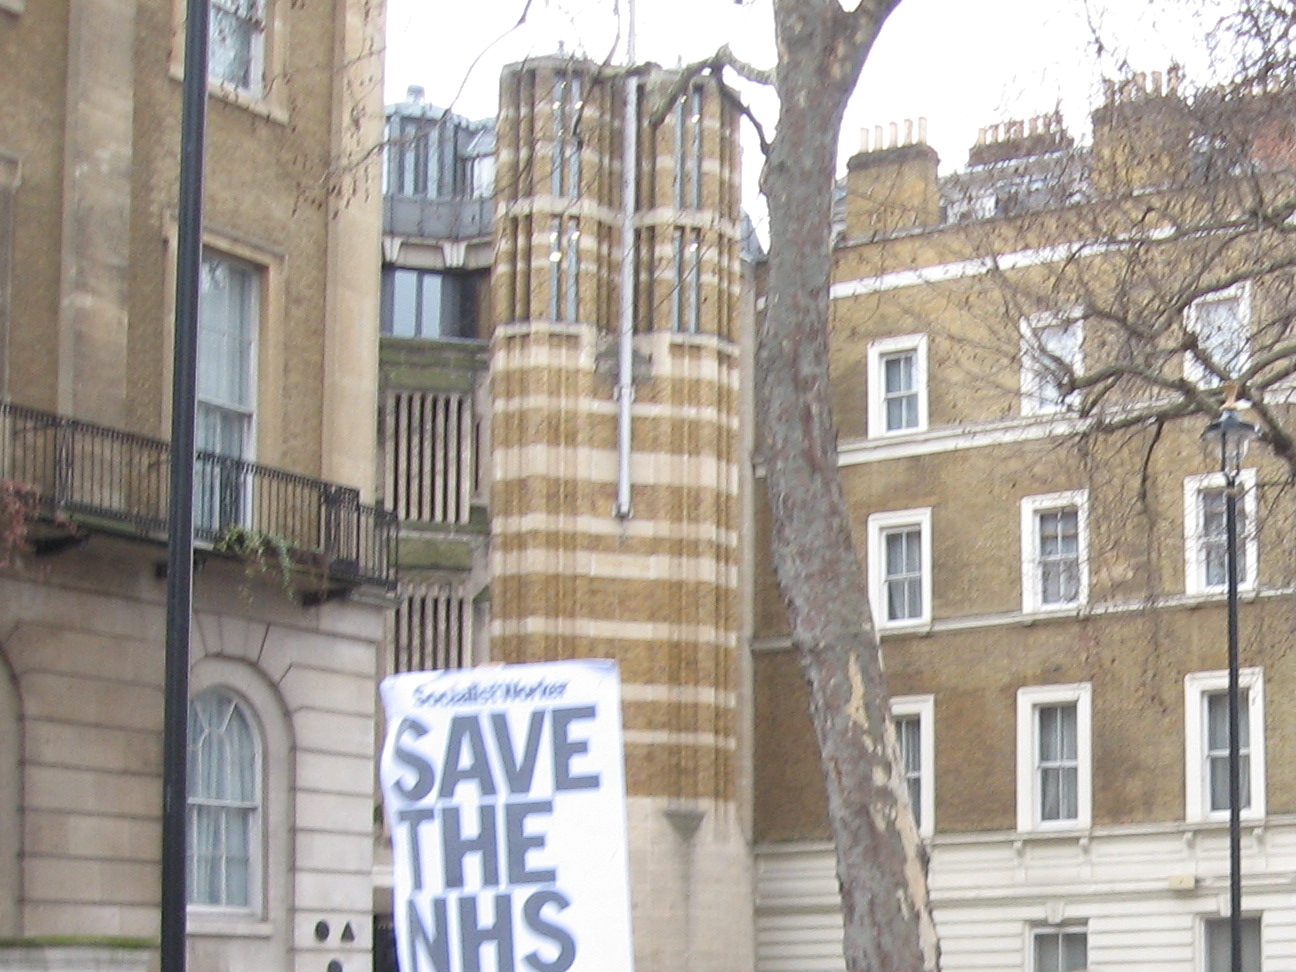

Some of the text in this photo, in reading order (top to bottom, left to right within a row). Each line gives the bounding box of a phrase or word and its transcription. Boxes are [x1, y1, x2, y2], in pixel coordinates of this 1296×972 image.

[413, 676, 570, 707] Socialist Worker
[390, 704, 600, 801] SAVE
[399, 800, 557, 890] THE
